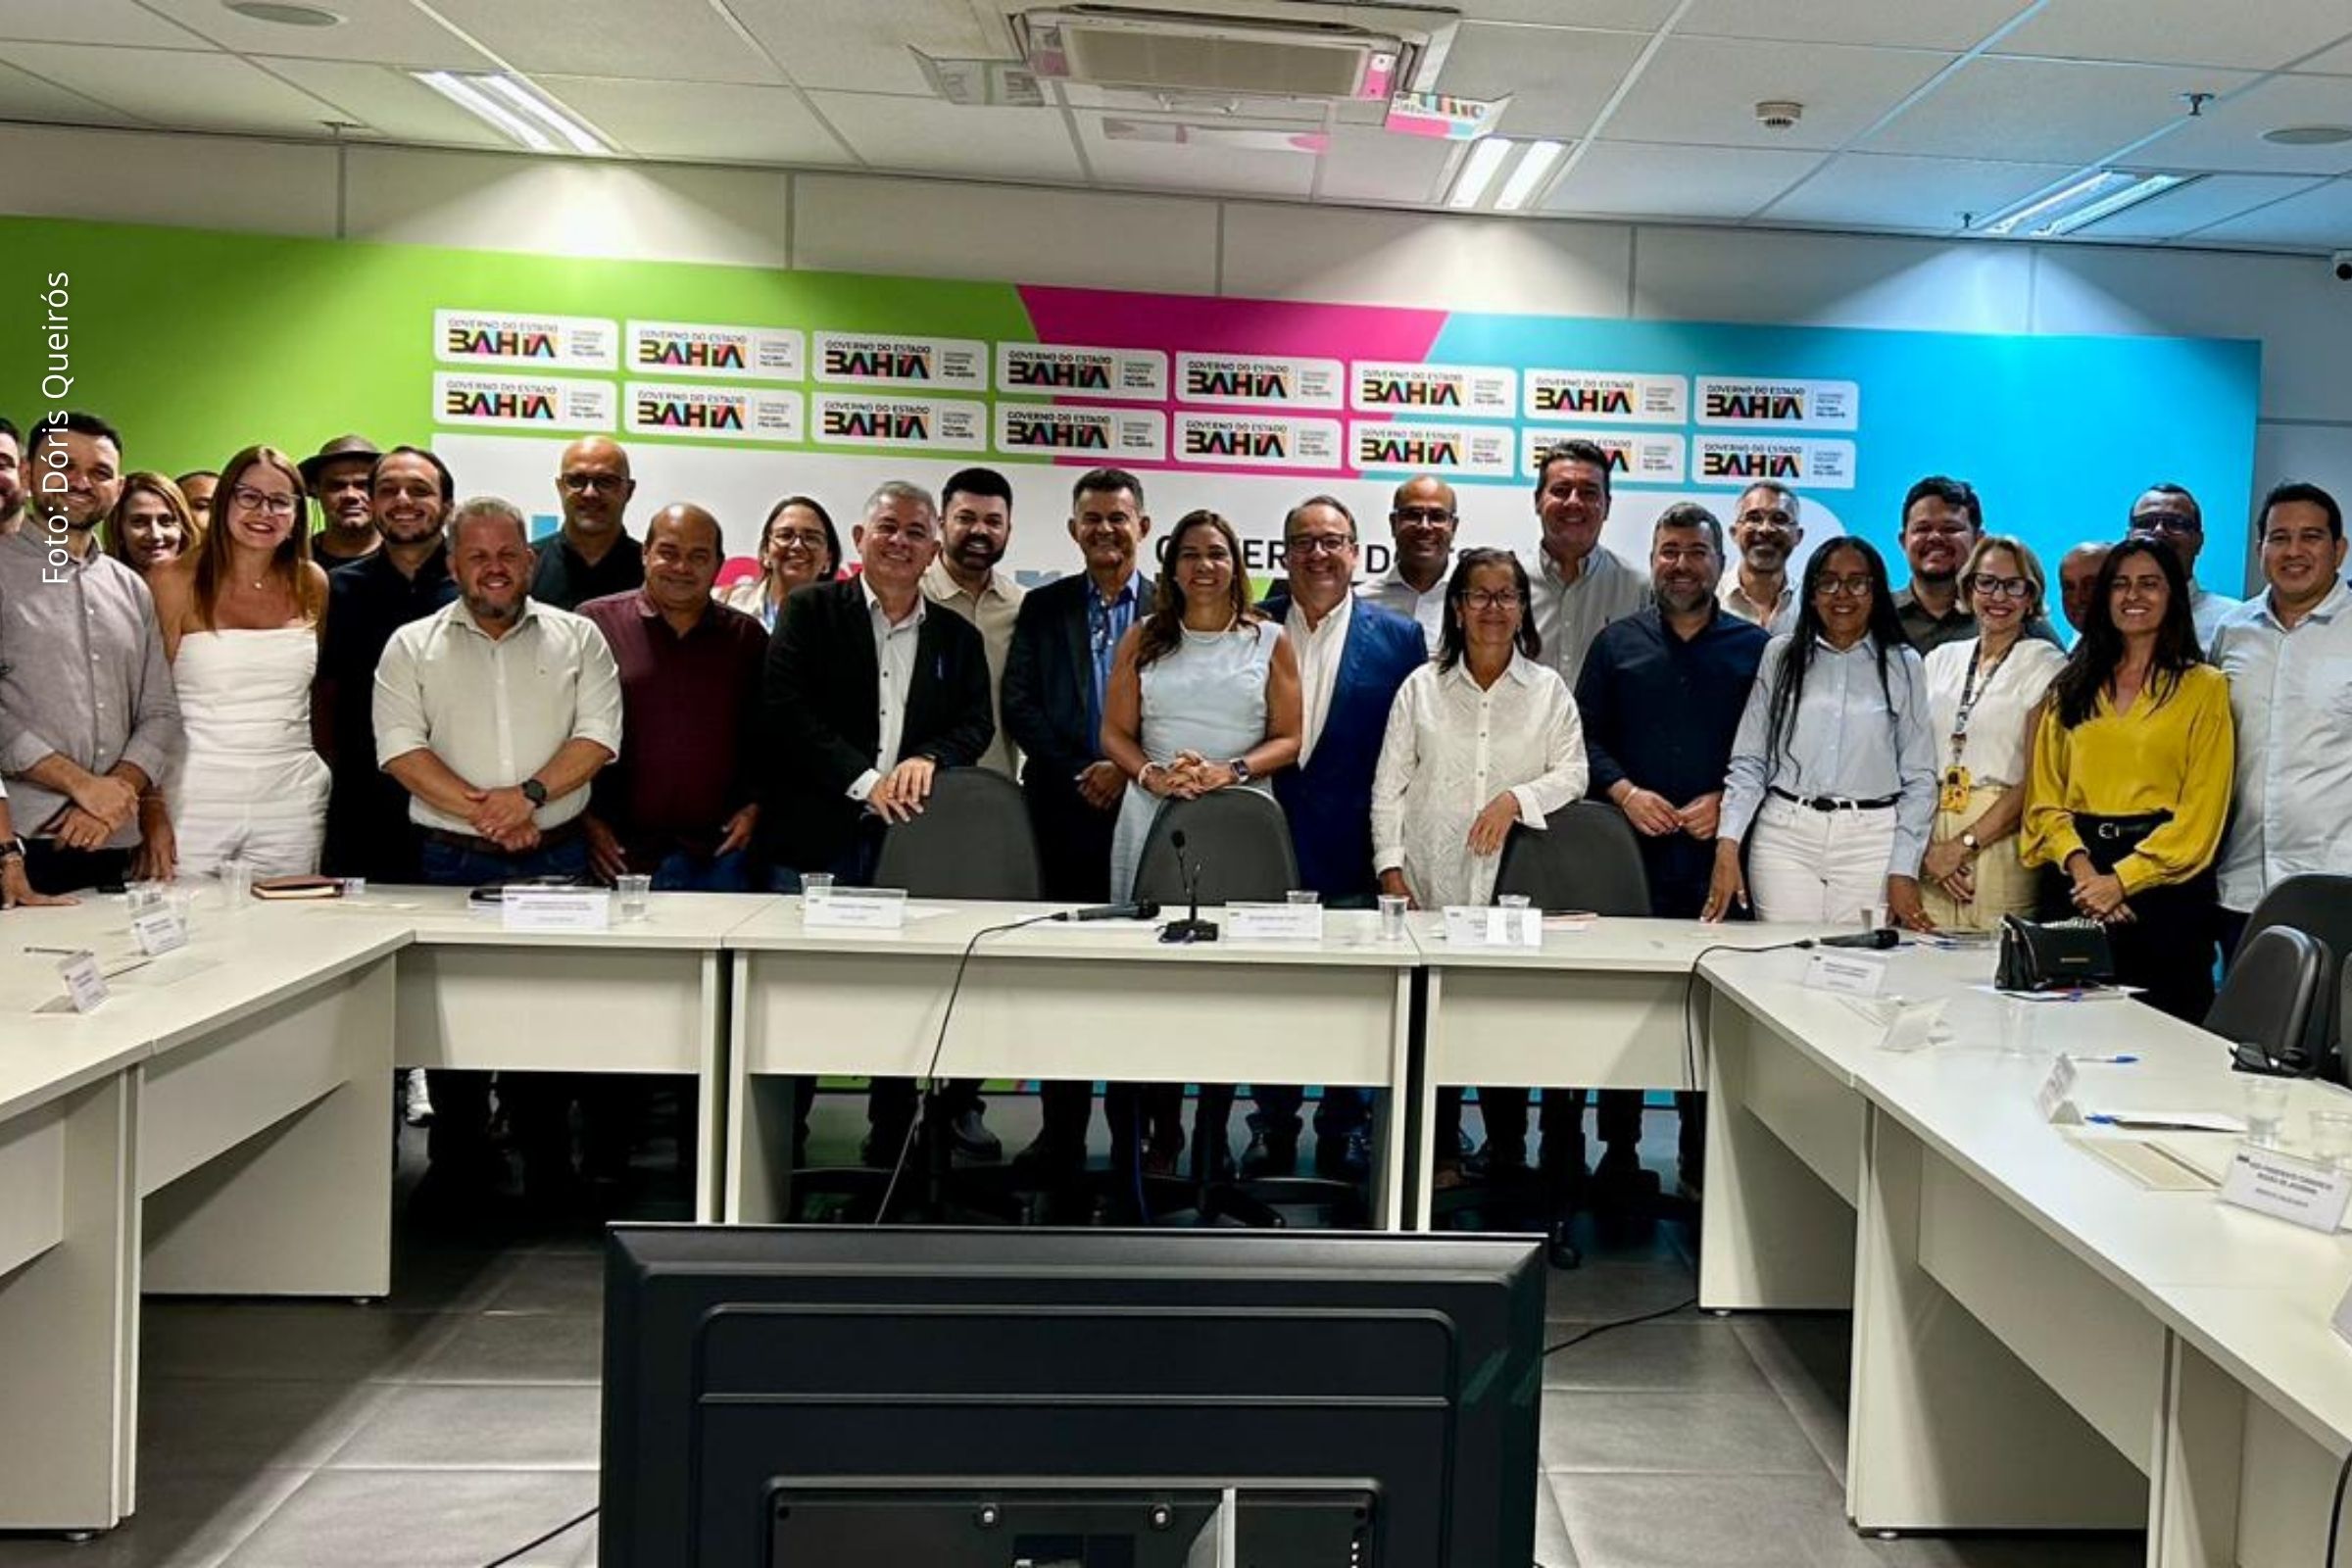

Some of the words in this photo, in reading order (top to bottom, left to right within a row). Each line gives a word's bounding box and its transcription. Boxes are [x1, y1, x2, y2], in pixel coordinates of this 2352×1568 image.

[449, 319, 499, 329] GOVERNO
[503, 321, 516, 330] DO
[520, 322, 559, 332] ESTADO
[449, 329, 556, 358] BAHIA
[639, 329, 689, 340] GOVERNO
[692, 332, 707, 341] DO
[709, 333, 747, 343] ESTADO
[639, 340, 745, 368] BAHIA
[825, 341, 875, 351] GOVERNO
[894, 344, 931, 354] ESTADO
[825, 351, 930, 379] BAHIA
[1008, 351, 1056, 361] GOVERNO
[1058, 354, 1073, 363] DO
[1075, 355, 1111, 365] ESTADO
[1188, 361, 1235, 370] GOVERNO
[1253, 365, 1290, 373] ESTADO
[1008, 361, 1110, 389] BAHIA
[1188, 370, 1287, 399] BAHIA
[1363, 370, 1409, 379] GOVERNO
[1427, 372, 1463, 381] ESTADO
[1536, 377, 1581, 387] GOVERNO
[1599, 380, 1634, 389] ESTADO
[447, 381, 498, 391] GOVERNO
[501, 383, 515, 392] DO
[517, 384, 558, 394] ESTADO
[1363, 379, 1460, 407] BAHIA
[1707, 385, 1752, 394] GOVERNO
[447, 390, 554, 419] BAHIA
[638, 391, 688, 401] GOVERNO
[690, 393, 705, 402] DO
[708, 394, 746, 404] ESTADO
[1536, 387, 1632, 414] BAHIA
[1706, 394, 1803, 419] BAHIA
[638, 401, 743, 430] BAHIA
[824, 402, 873, 412] GOVERNO
[875, 404, 889, 413] DO
[893, 405, 931, 415] ESTADO
[1007, 411, 1054, 421] GOVERNO
[1073, 415, 1110, 423] ESTADO
[824, 412, 928, 440] BAHIA
[1007, 420, 1108, 449] BAHIA
[1186, 420, 1233, 430] GOVERNO
[1235, 422, 1250, 431] DO
[1251, 423, 1287, 433] ESTADO
[1361, 429, 1407, 438] GOVERNO
[1186, 430, 1286, 458] BAHIA
[1360, 438, 1457, 466] BAHIA
[1704, 443, 1748, 453] GOVERNO
[1768, 445, 1802, 454] ESTADO
[1704, 453, 1799, 477] BAHIA
